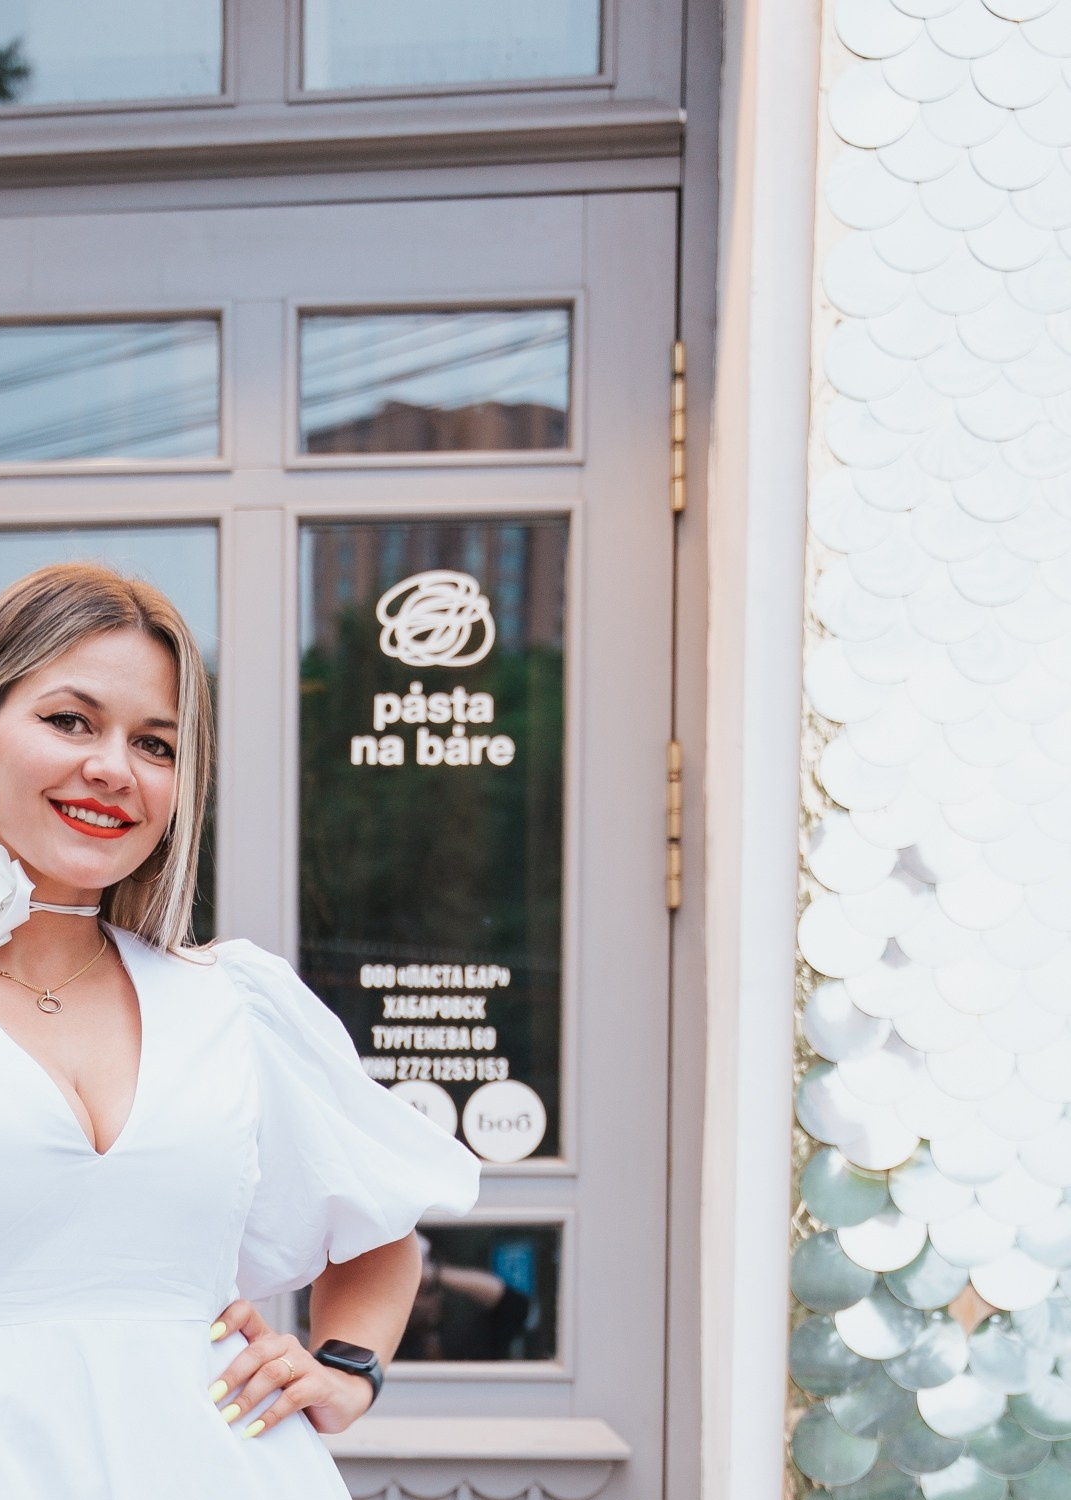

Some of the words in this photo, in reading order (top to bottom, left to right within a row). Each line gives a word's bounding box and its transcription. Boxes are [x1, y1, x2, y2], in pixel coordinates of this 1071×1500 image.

[351, 735, 404, 765] na
[360, 964, 396, 988] ООО
[383, 995, 487, 1019] ХАБАРОВСК
[371, 1025, 471, 1050] ТУРГЕНЕВА
[396, 1056, 509, 1081] 2721253153
